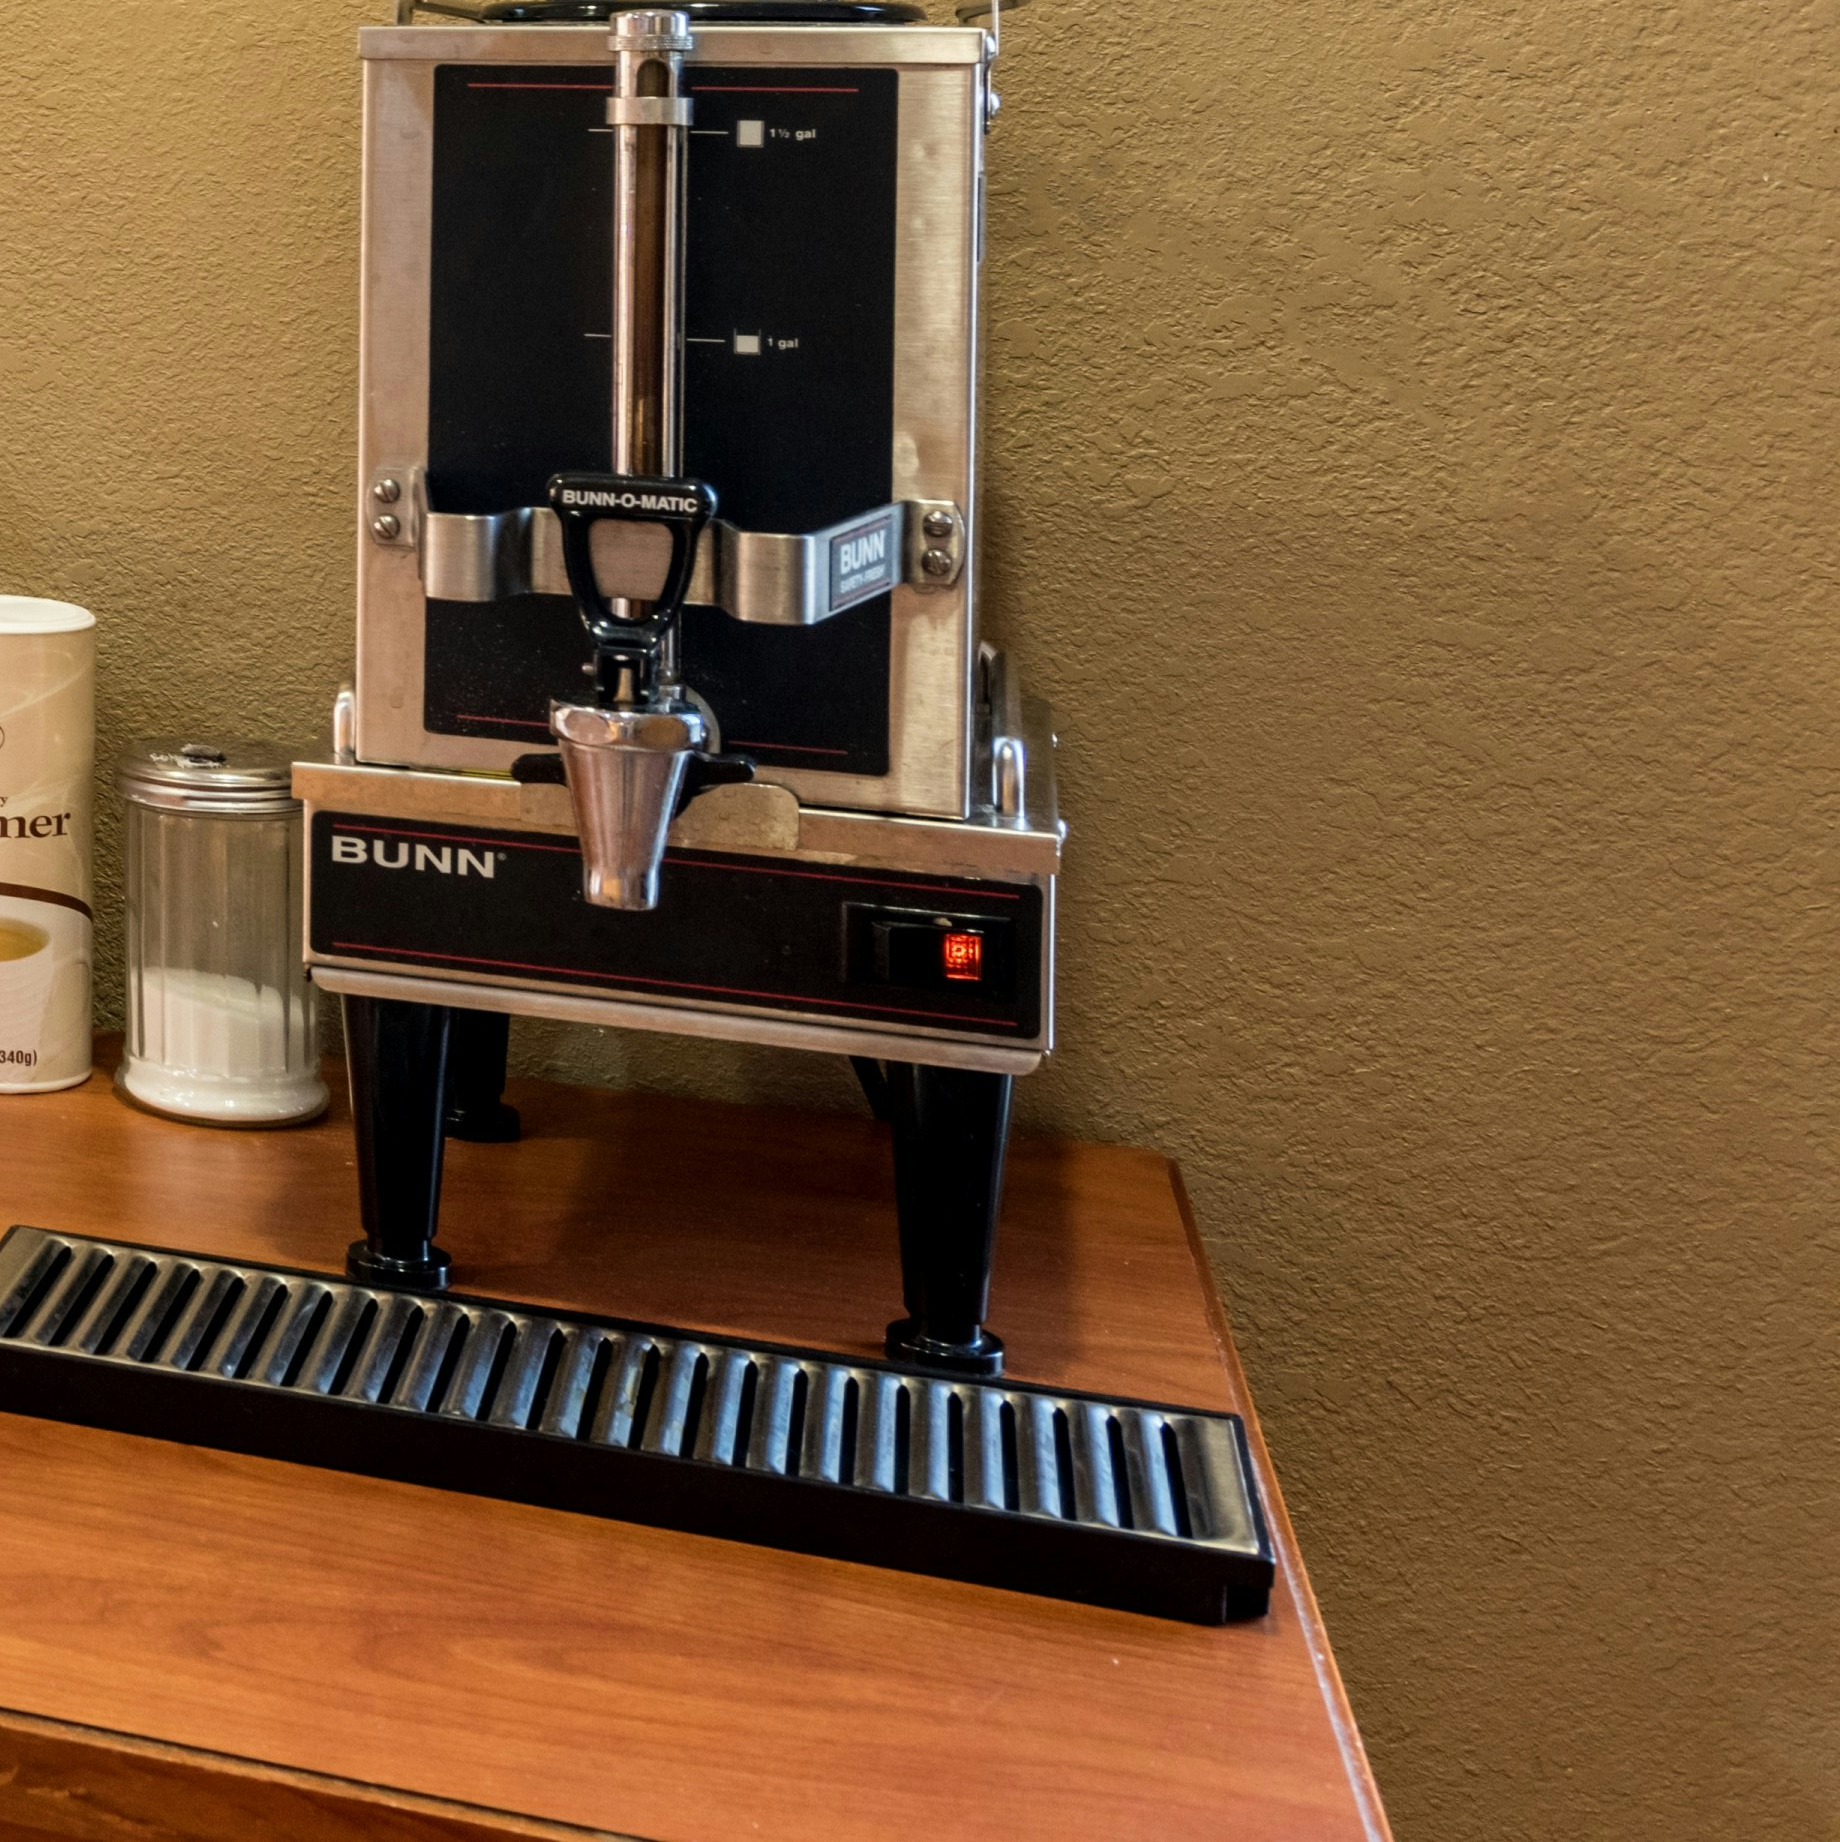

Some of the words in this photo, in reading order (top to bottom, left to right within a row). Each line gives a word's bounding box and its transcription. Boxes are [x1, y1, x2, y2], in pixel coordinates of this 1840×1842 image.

[795, 128, 816, 141] gal
[778, 338, 799, 350] gal
[562, 489, 698, 513] BUNN-O-MATIC
[840, 529, 887, 575] BUNN
[331, 835, 495, 878] BUNN
